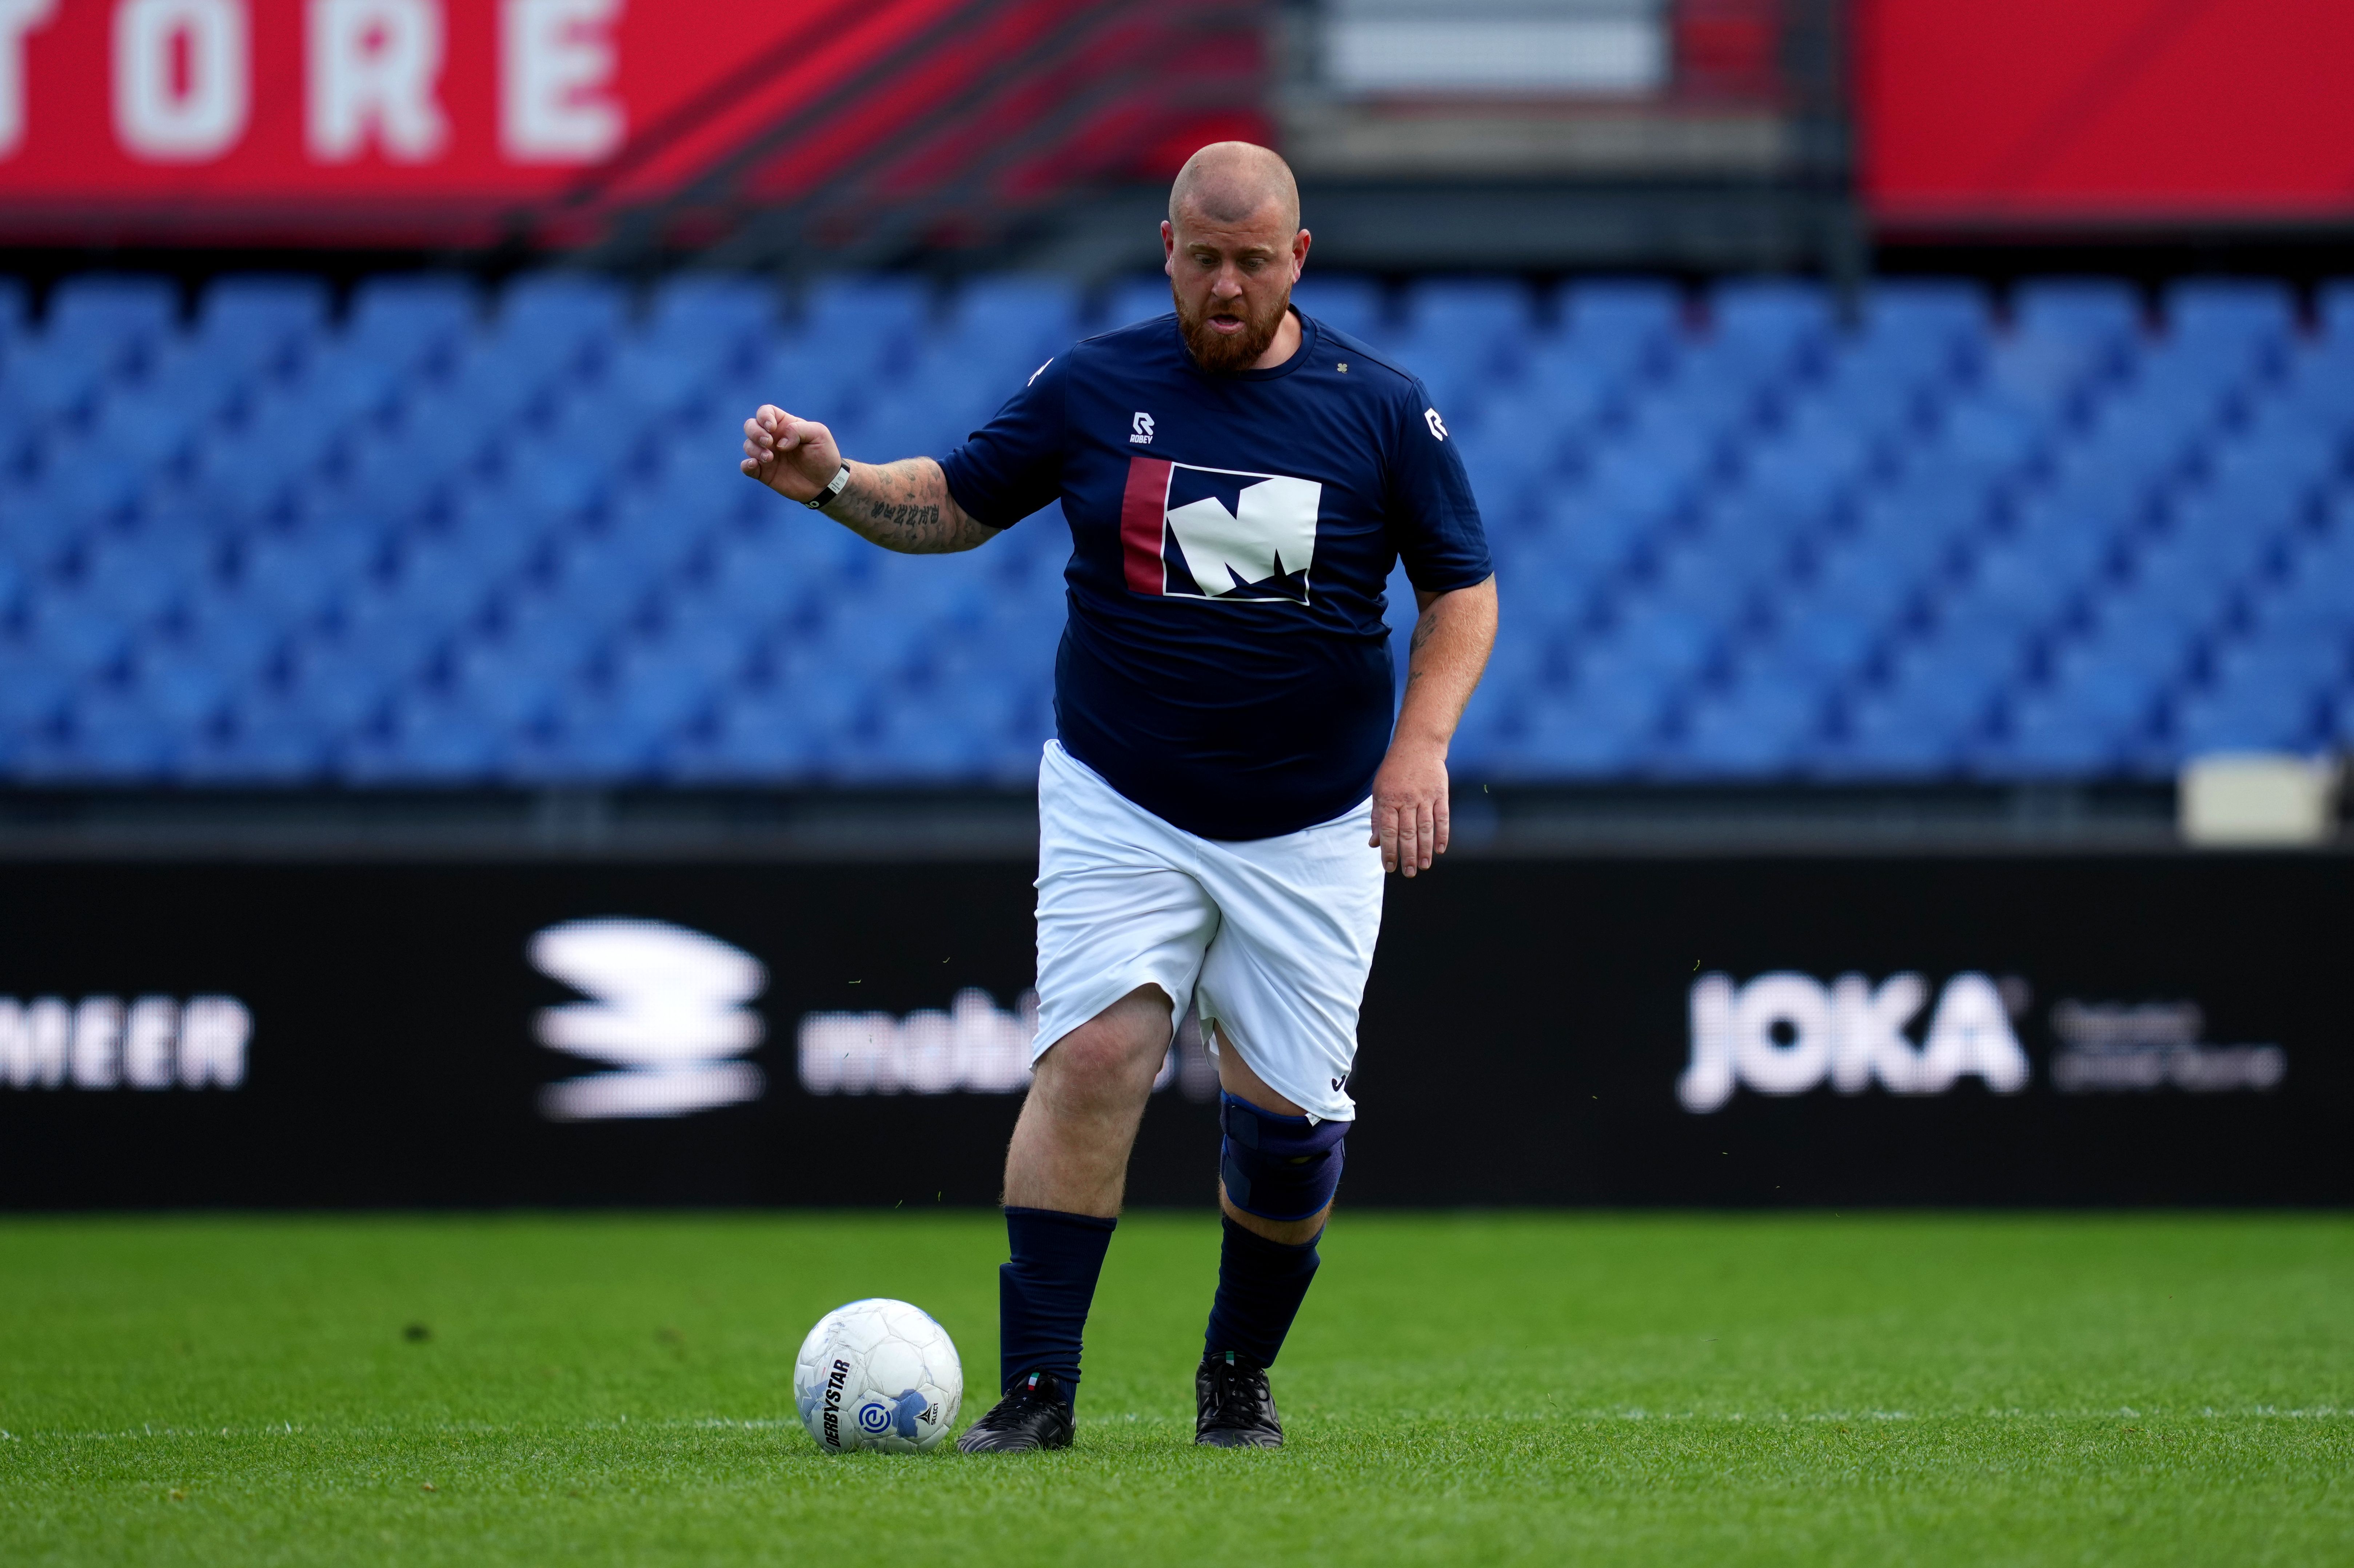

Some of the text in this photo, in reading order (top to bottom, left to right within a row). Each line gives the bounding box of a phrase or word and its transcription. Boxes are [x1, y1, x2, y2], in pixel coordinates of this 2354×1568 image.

[1130, 434, 1153, 444] ROBEY
[1677, 970, 2029, 1112] JOKA
[824, 1359, 850, 1448] DERBYSTAR
